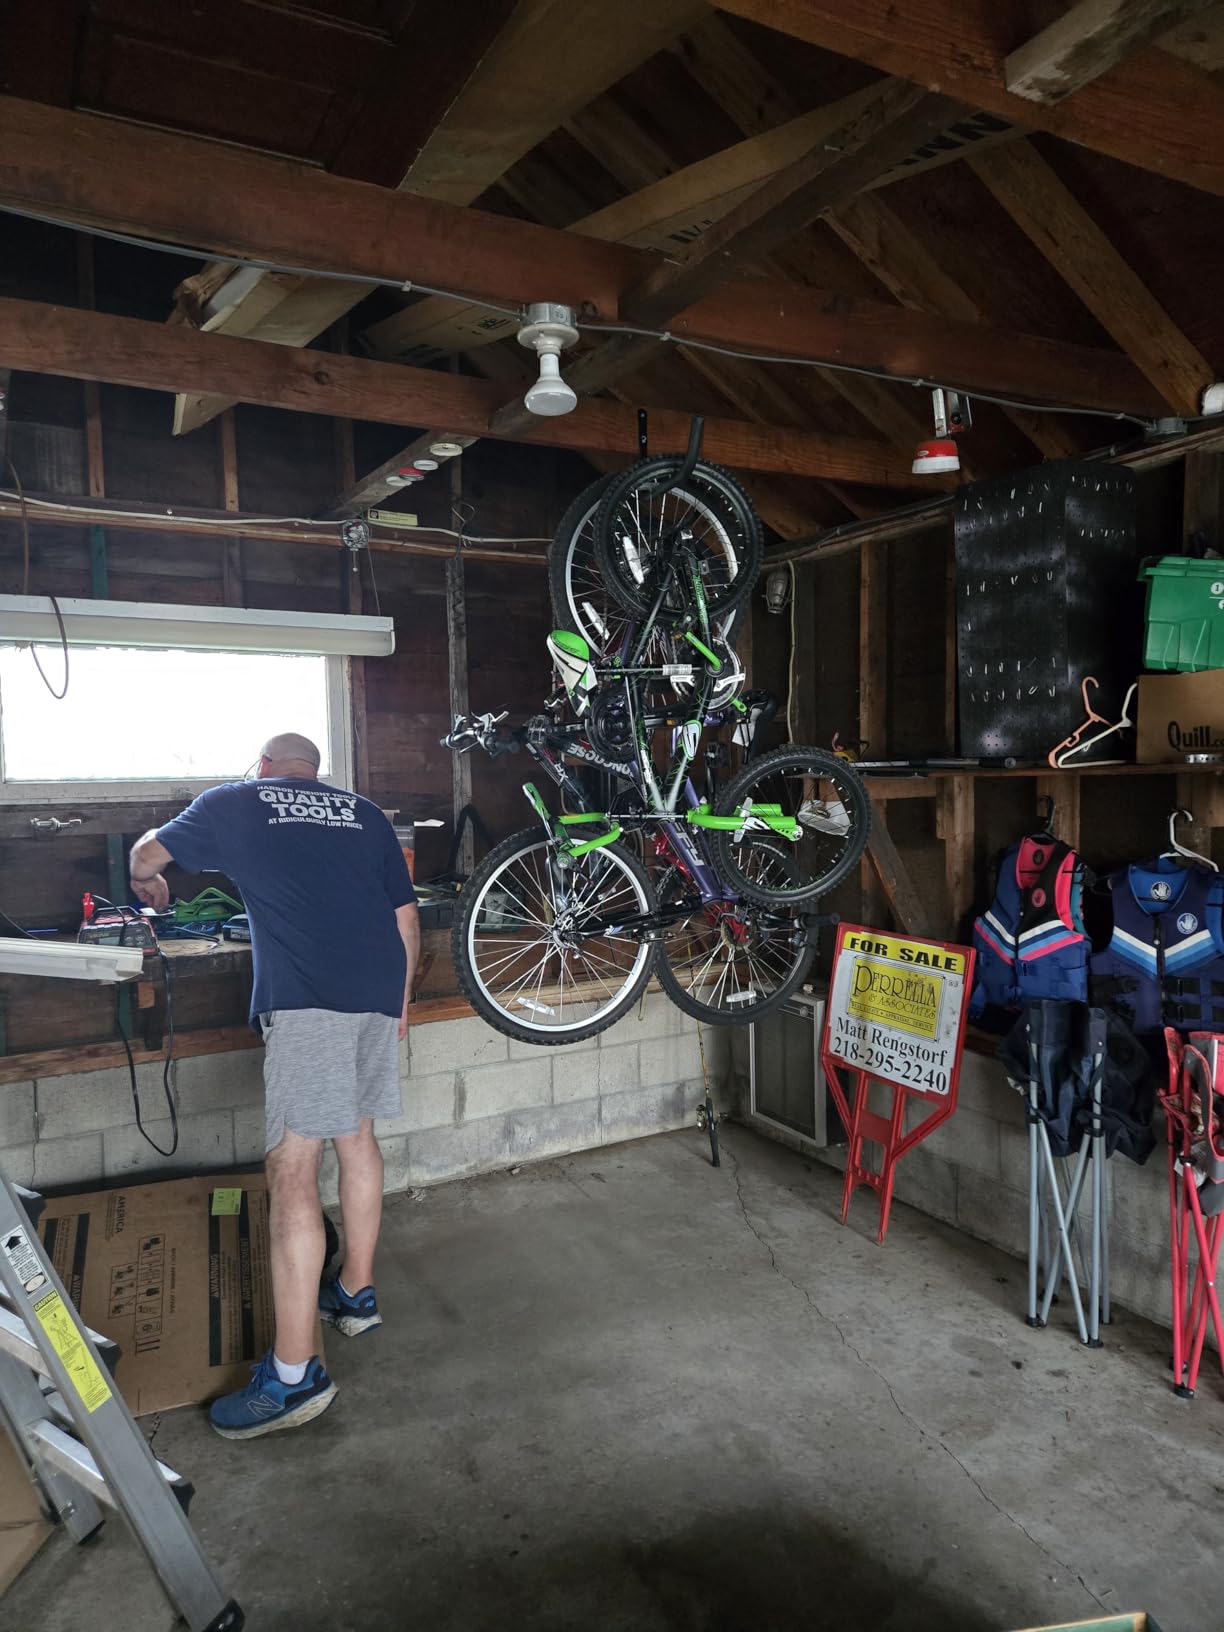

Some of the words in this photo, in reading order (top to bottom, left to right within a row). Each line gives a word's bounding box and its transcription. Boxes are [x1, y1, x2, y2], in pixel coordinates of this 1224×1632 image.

[257, 786, 294, 794] HARBOR
[295, 789, 331, 797] FREIGHT
[259, 790, 358, 809] QUALITY
[271, 803, 356, 822] TOOLS
[278, 817, 327, 826] RIDICULOUSLY
[342, 821, 364, 830] PRICES
[849, 937, 888, 956] FOR
[899, 948, 957, 972] SALE
[852, 964, 937, 1008] PERRELLA
[869, 993, 877, 1002] &
[878, 996, 936, 1020] ASSOCIATES
[837, 1017, 868, 1041] Matt
[871, 1027, 948, 1067] Rengstorf
[833, 1036, 947, 1092] 218-295-2240
[115, 1195, 126, 1234] AMERICA
[209, 1254, 220, 1292] WARNING
[34, 1291, 58, 1312] CAUTION
